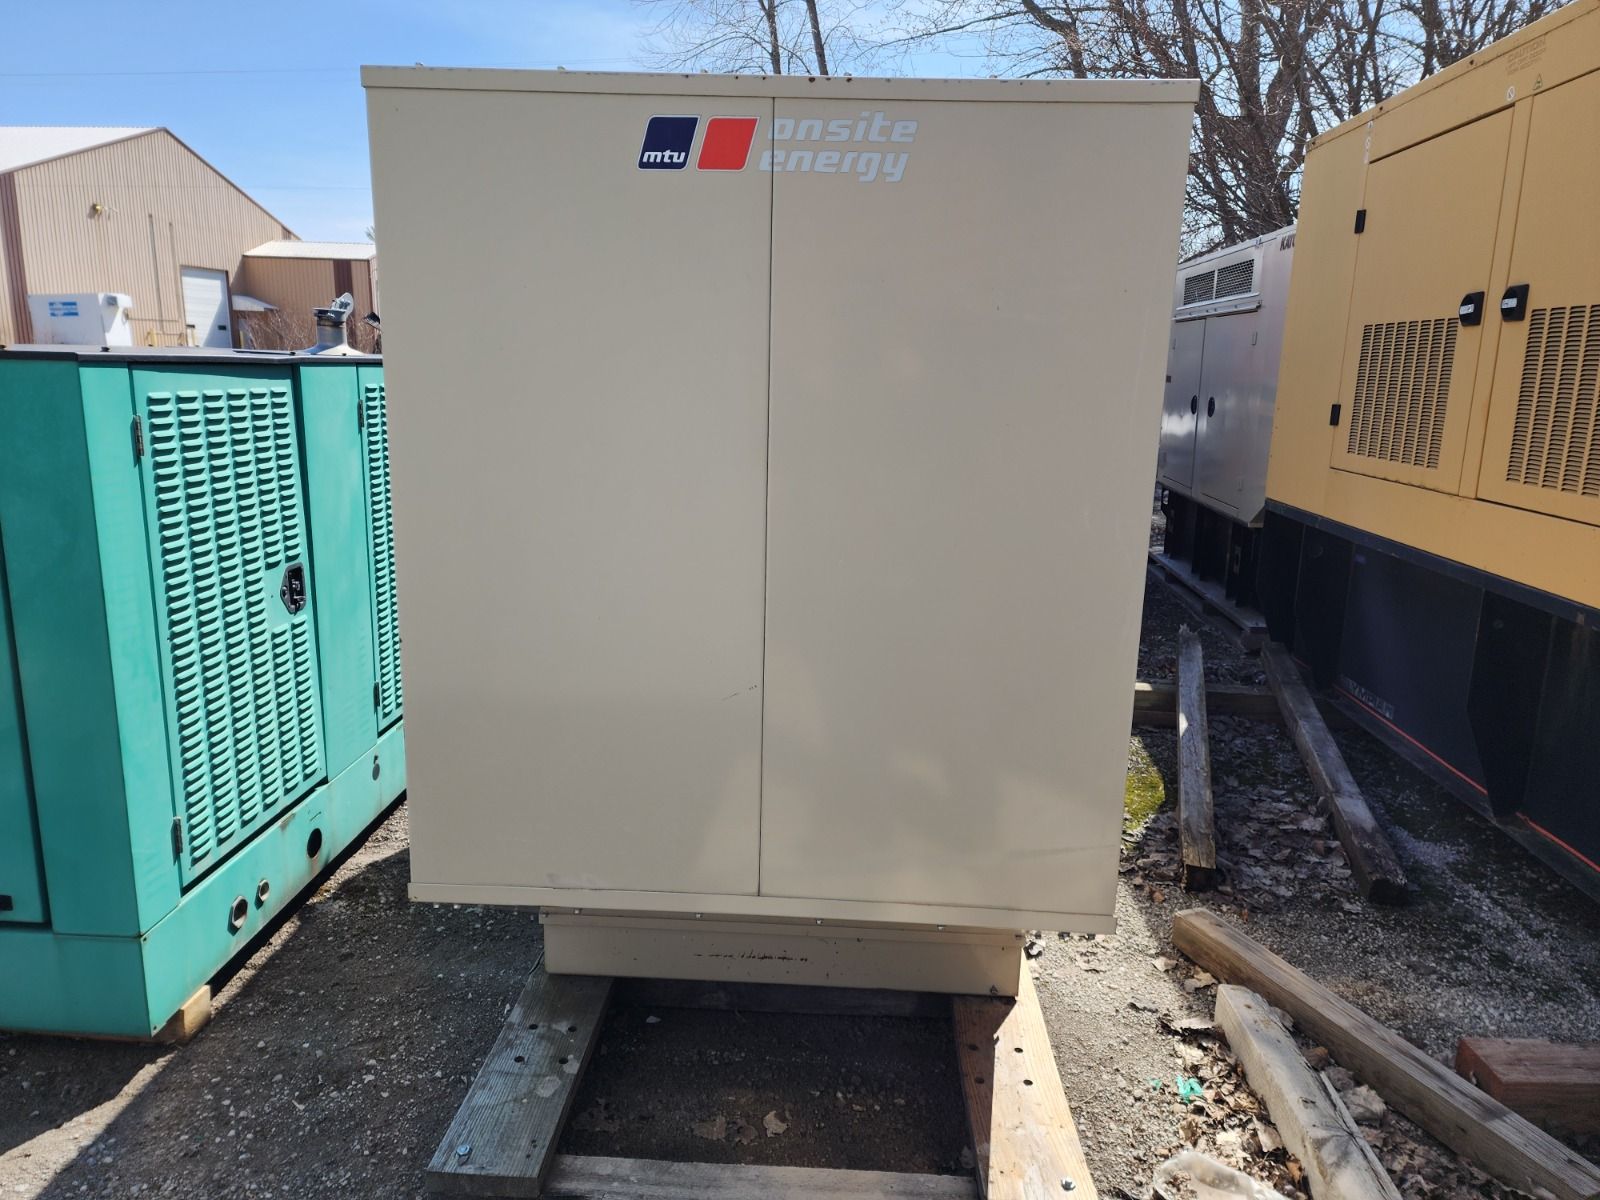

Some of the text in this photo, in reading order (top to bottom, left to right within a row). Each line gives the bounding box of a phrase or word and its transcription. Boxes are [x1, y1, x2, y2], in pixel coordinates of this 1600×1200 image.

[767, 111, 918, 143] onsite
[642, 149, 686, 163] mtu
[759, 150, 909, 183] energy
